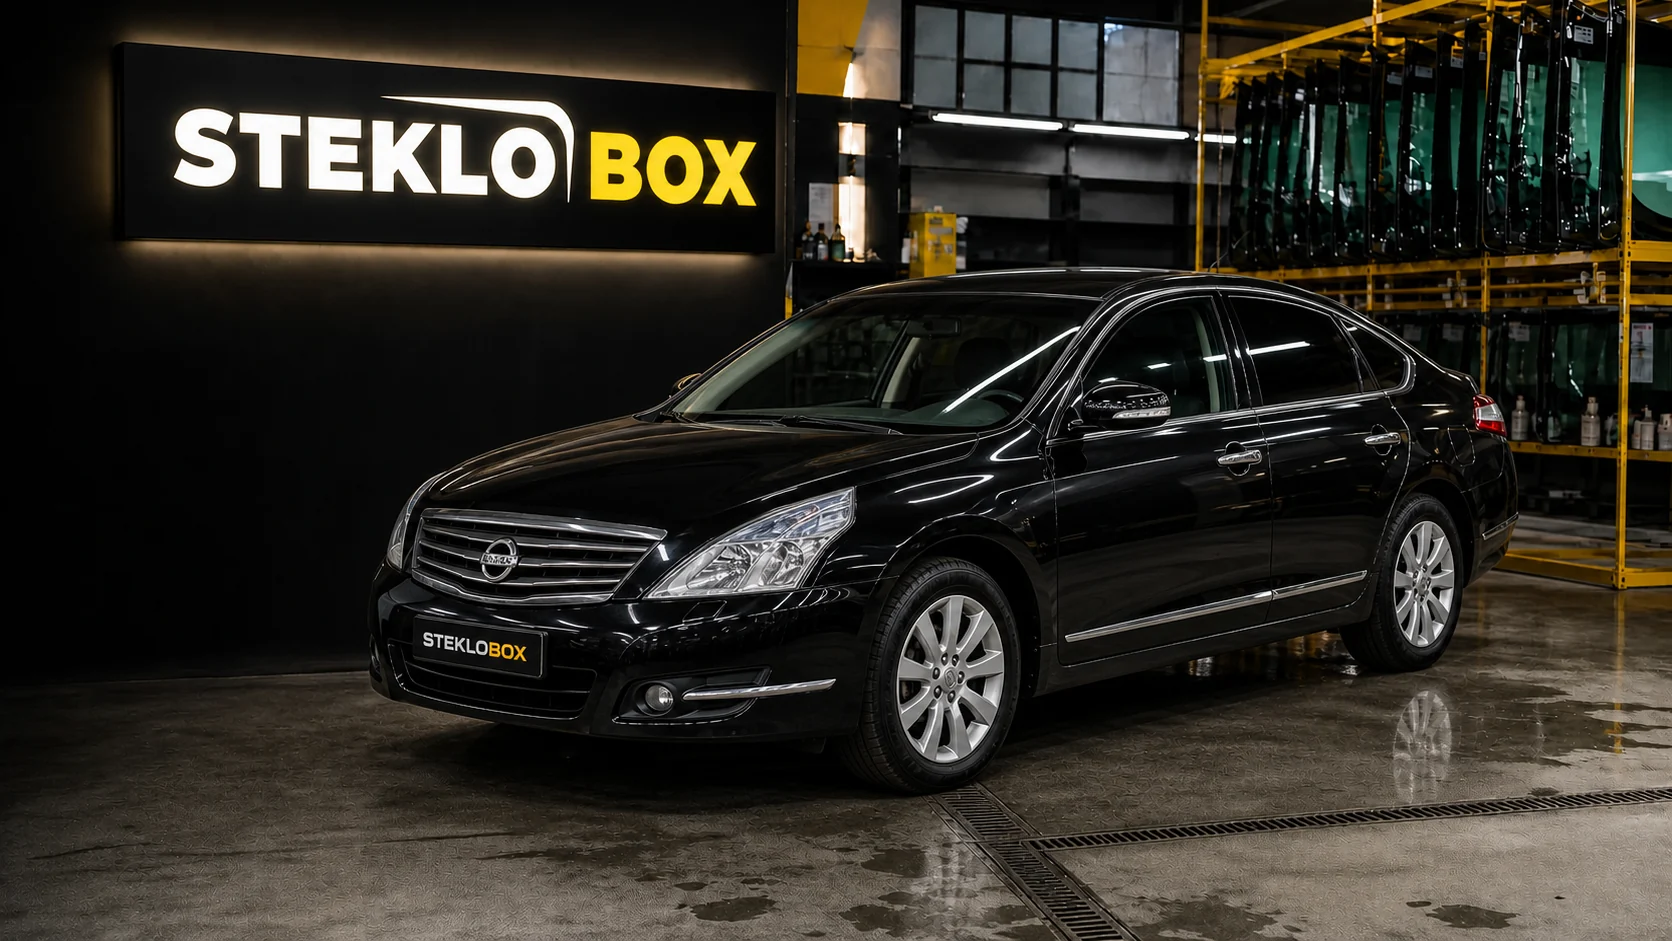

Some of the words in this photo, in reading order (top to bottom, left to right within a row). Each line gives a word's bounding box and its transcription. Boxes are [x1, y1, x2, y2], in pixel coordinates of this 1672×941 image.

[173, 108, 556, 199] STEKLO
[590, 131, 757, 207] BOX
[422, 631, 527, 662] STEKLOBOX
